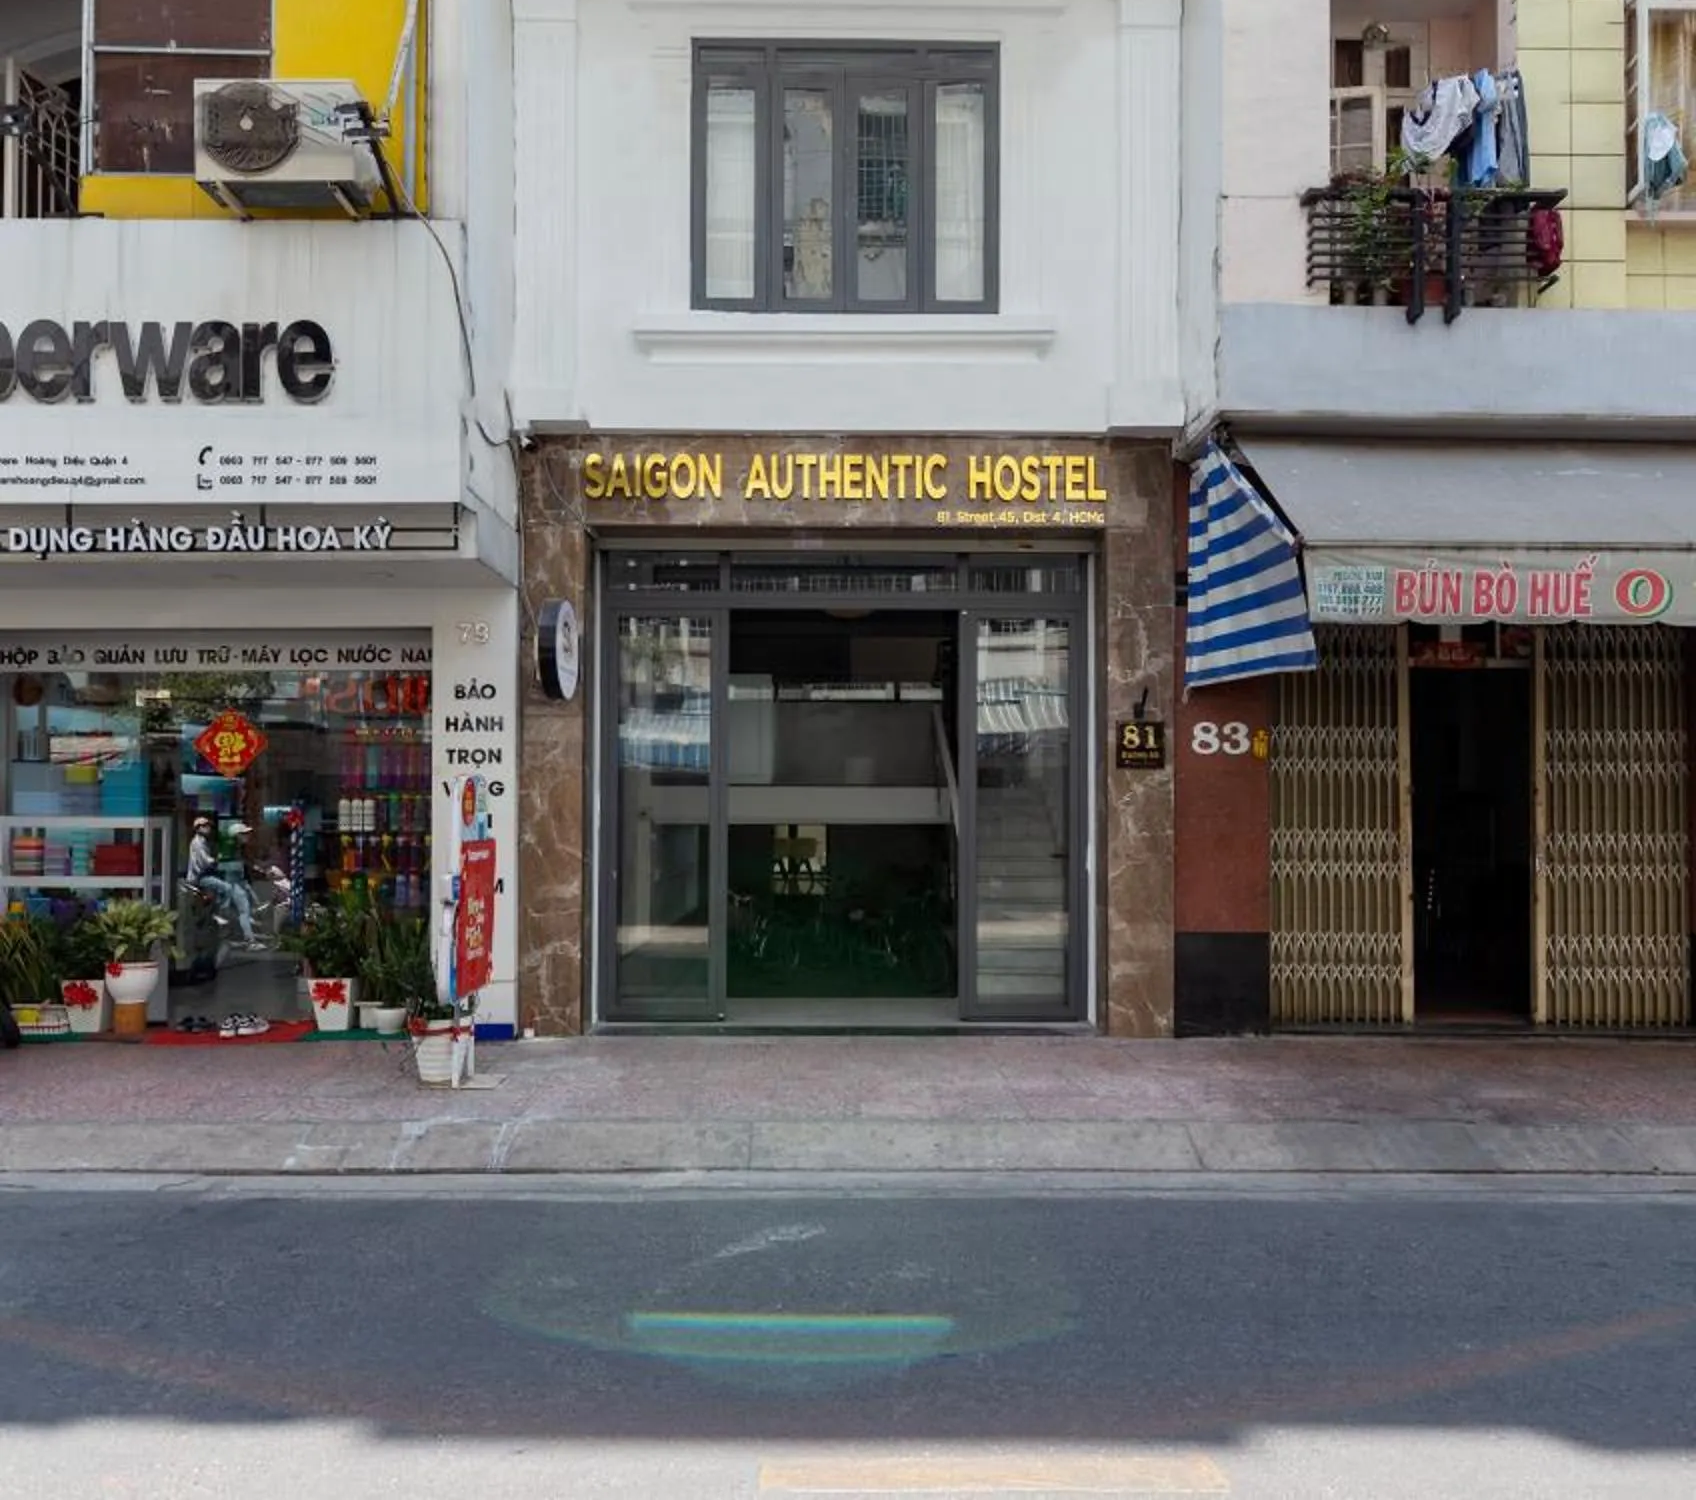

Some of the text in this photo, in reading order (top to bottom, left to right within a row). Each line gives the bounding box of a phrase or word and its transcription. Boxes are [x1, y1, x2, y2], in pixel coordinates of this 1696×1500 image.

[0, 319, 337, 405] erware
[584, 452, 1107, 502] SAIGON AUTHENTIC HOSTEL
[957, 510, 994, 523] Street
[1023, 510, 1046, 523] Dist
[9, 510, 392, 560] DỤNG HÀNG ĐẦU HOA KỲ
[1395, 558, 1463, 616] BÚN
[1473, 560, 1518, 617] BÒ
[1528, 553, 1600, 617] HUẾ
[0, 647, 38, 667] HỘP
[155, 648, 187, 664] LƯU
[290, 648, 328, 666] LỌC
[337, 644, 392, 663] NƯỚC
[401, 648, 431, 663] NA
[454, 677, 496, 700] BẢO
[445, 711, 504, 733] HÀNH
[1123, 724, 1157, 749] 81
[1191, 721, 1251, 755] 83
[445, 748, 502, 768] TRỌN
